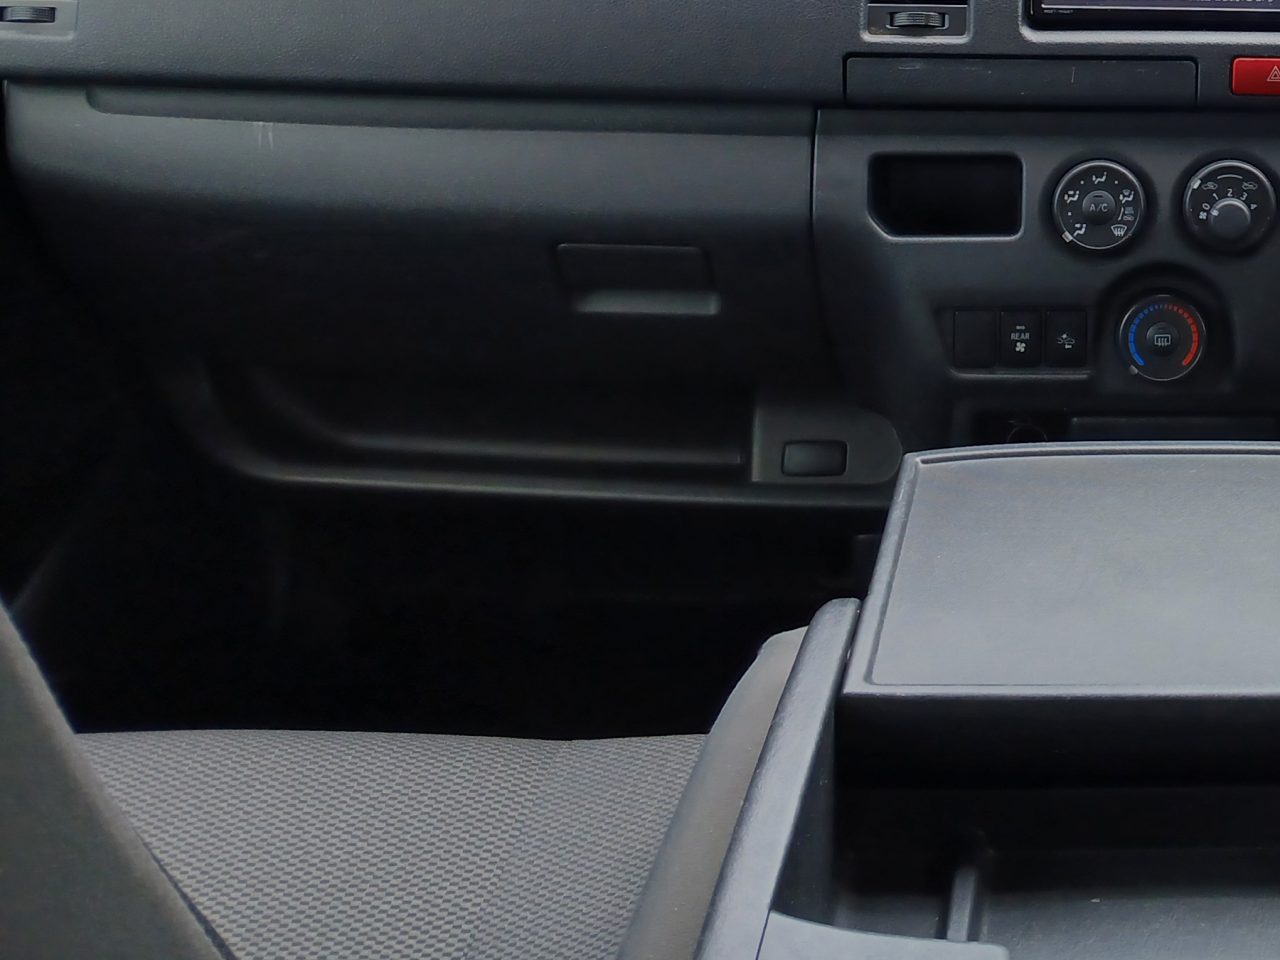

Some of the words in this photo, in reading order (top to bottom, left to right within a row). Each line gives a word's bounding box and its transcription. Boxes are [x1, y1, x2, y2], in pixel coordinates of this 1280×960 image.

[1227, 188, 1233, 197] 2
[1240, 192, 1248, 201] 3
[1089, 203, 1108, 213] A/C
[1011, 332, 1030, 340] REAR
